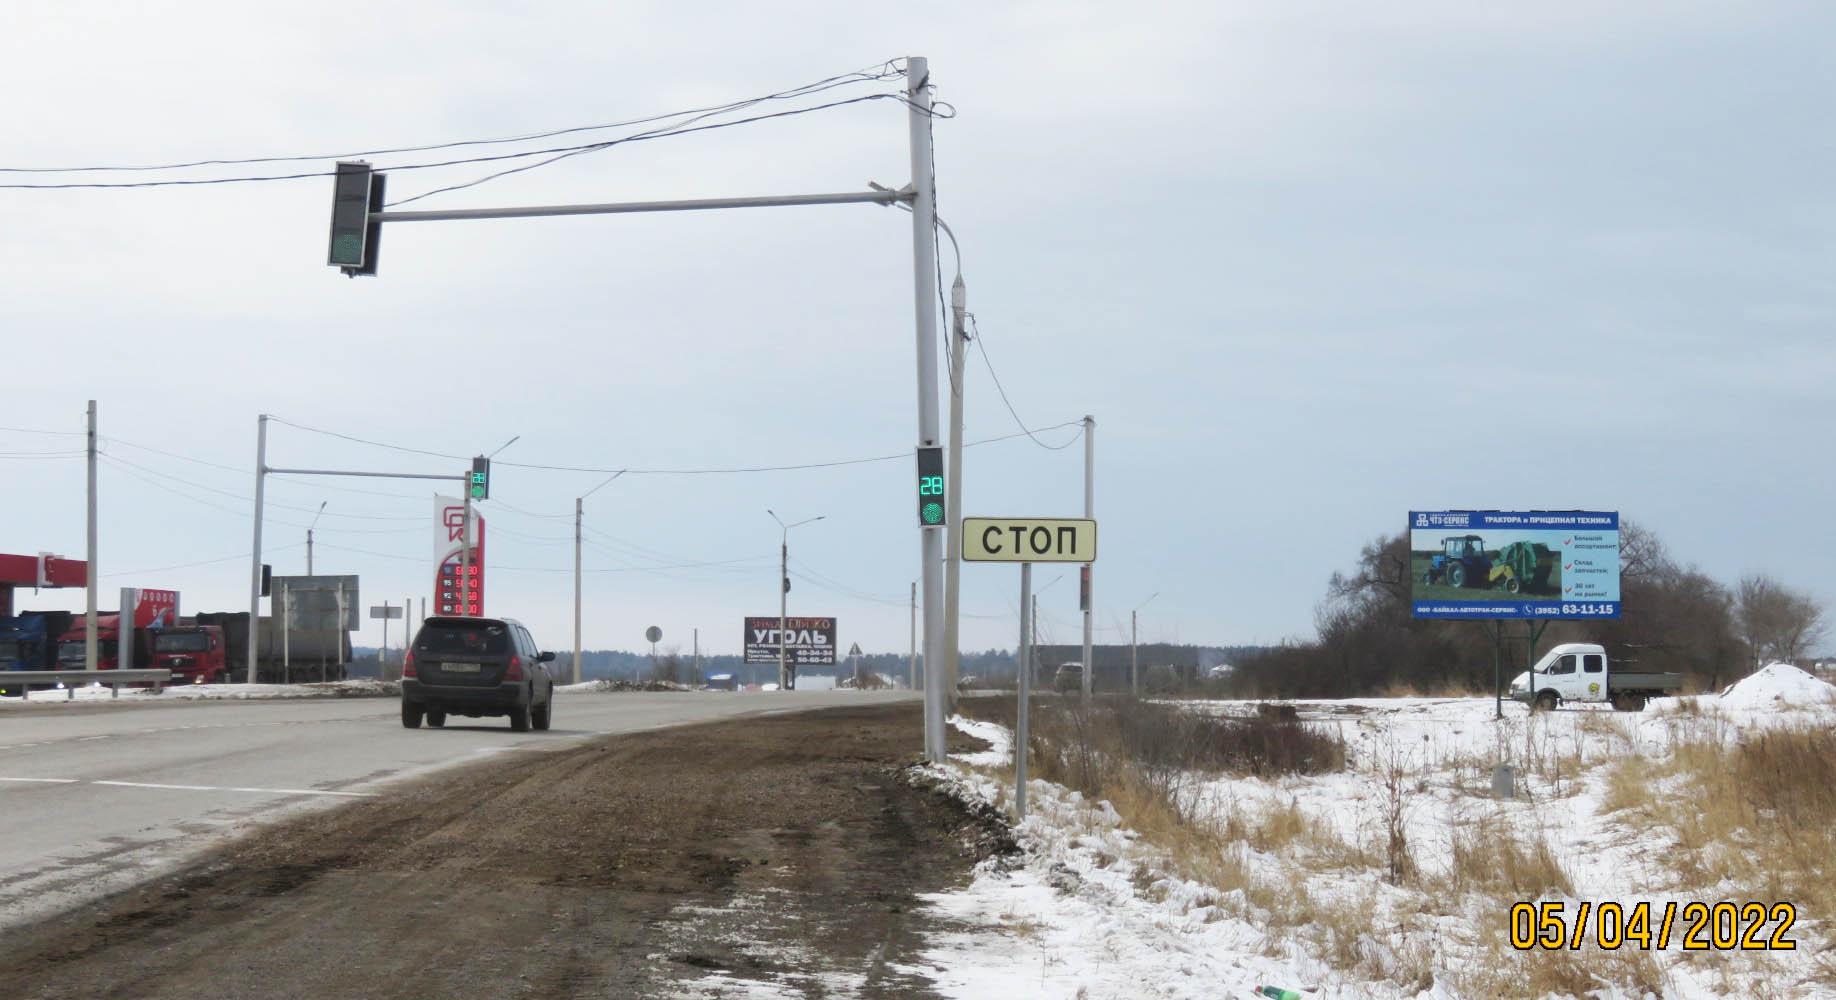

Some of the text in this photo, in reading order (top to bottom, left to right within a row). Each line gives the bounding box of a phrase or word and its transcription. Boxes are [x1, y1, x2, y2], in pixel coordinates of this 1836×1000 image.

[920, 477, 943, 495] 28
[1530, 516, 1576, 524] ПРИЦЕПНАЯ
[982, 526, 1076, 554] СТОП
[1535, 607, 1560, 615] (3952)
[1562, 604, 1613, 614] 63-11-15
[753, 629, 827, 644] УГОЛЬ
